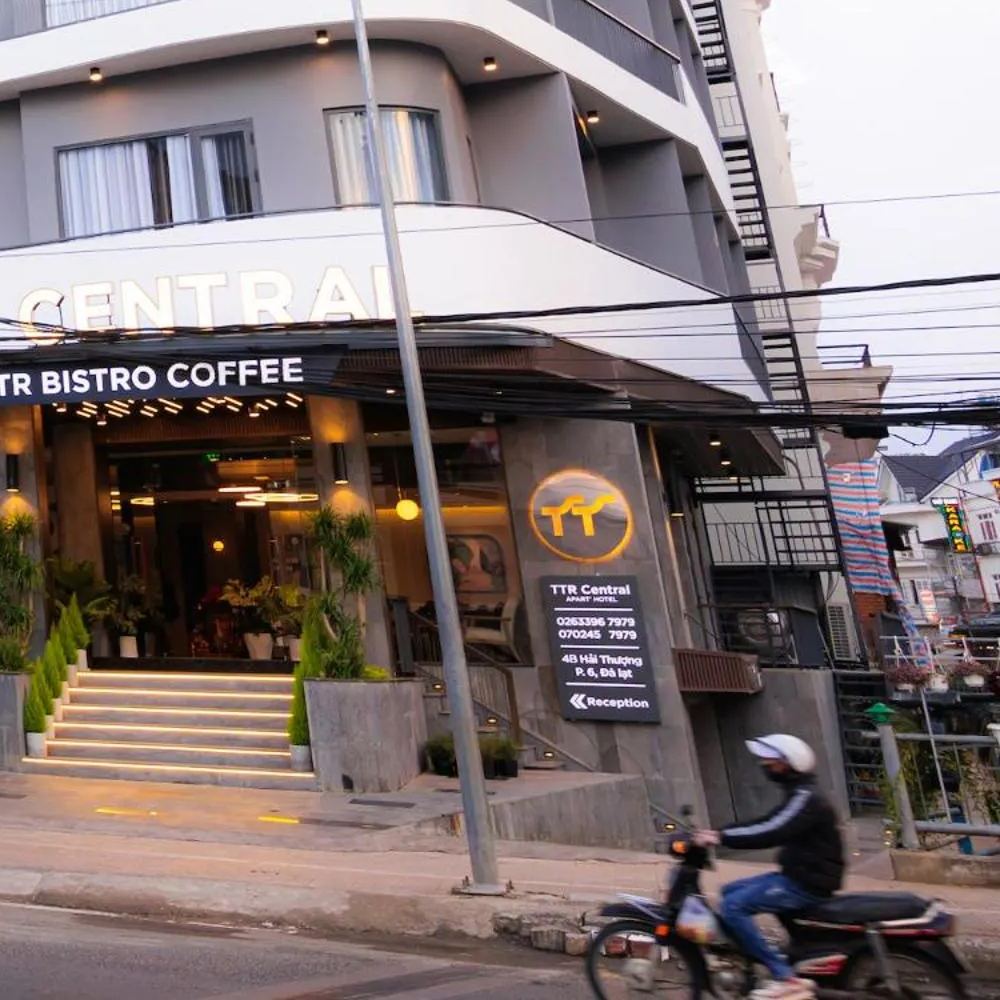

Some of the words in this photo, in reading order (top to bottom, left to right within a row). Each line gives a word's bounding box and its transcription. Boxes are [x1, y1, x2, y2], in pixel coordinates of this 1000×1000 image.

[41, 366, 157, 395] BISTRO
[167, 357, 304, 388] COFFEE
[549, 584, 577, 595] TTR
[581, 584, 631, 595] Central
[607, 618, 635, 627] 7979
[609, 630, 637, 640] 7979
[587, 697, 650, 709] Reception
